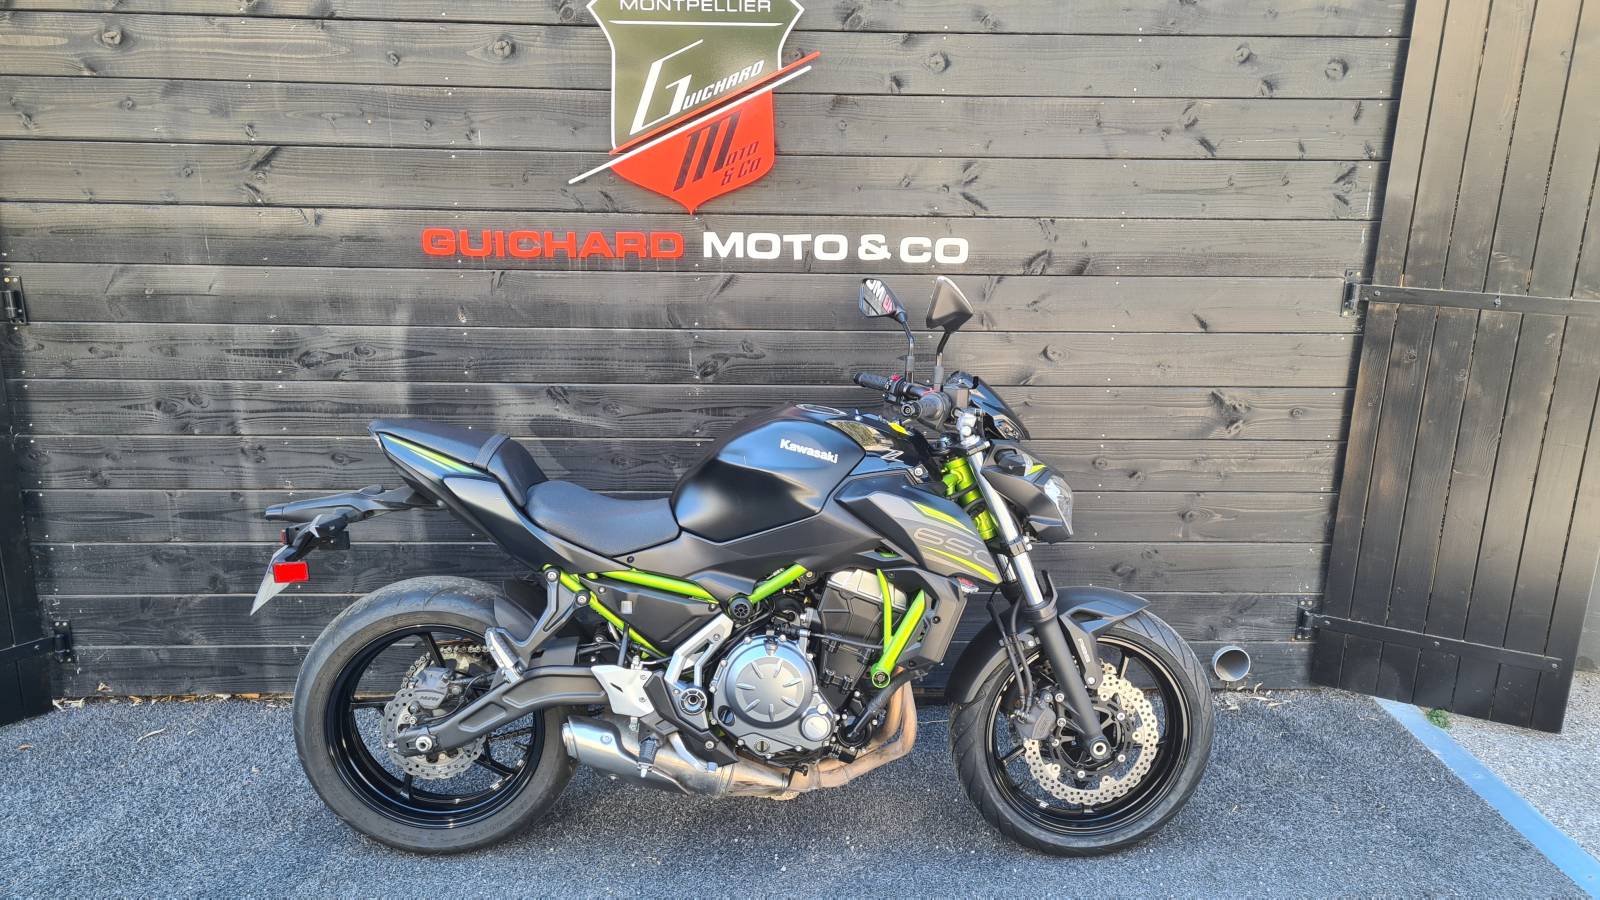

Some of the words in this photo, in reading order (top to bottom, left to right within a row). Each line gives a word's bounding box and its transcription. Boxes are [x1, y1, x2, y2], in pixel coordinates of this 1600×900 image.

[619, 0, 771, 12] MONTPELLIER
[629, 39, 765, 136] GUICHARD
[721, 167, 734, 186] &
[421, 228, 684, 259] GUICHARD
[703, 231, 849, 261] MOTO
[857, 233, 892, 261] &
[899, 236, 969, 264] CO
[780, 438, 839, 464] Kawasaki
